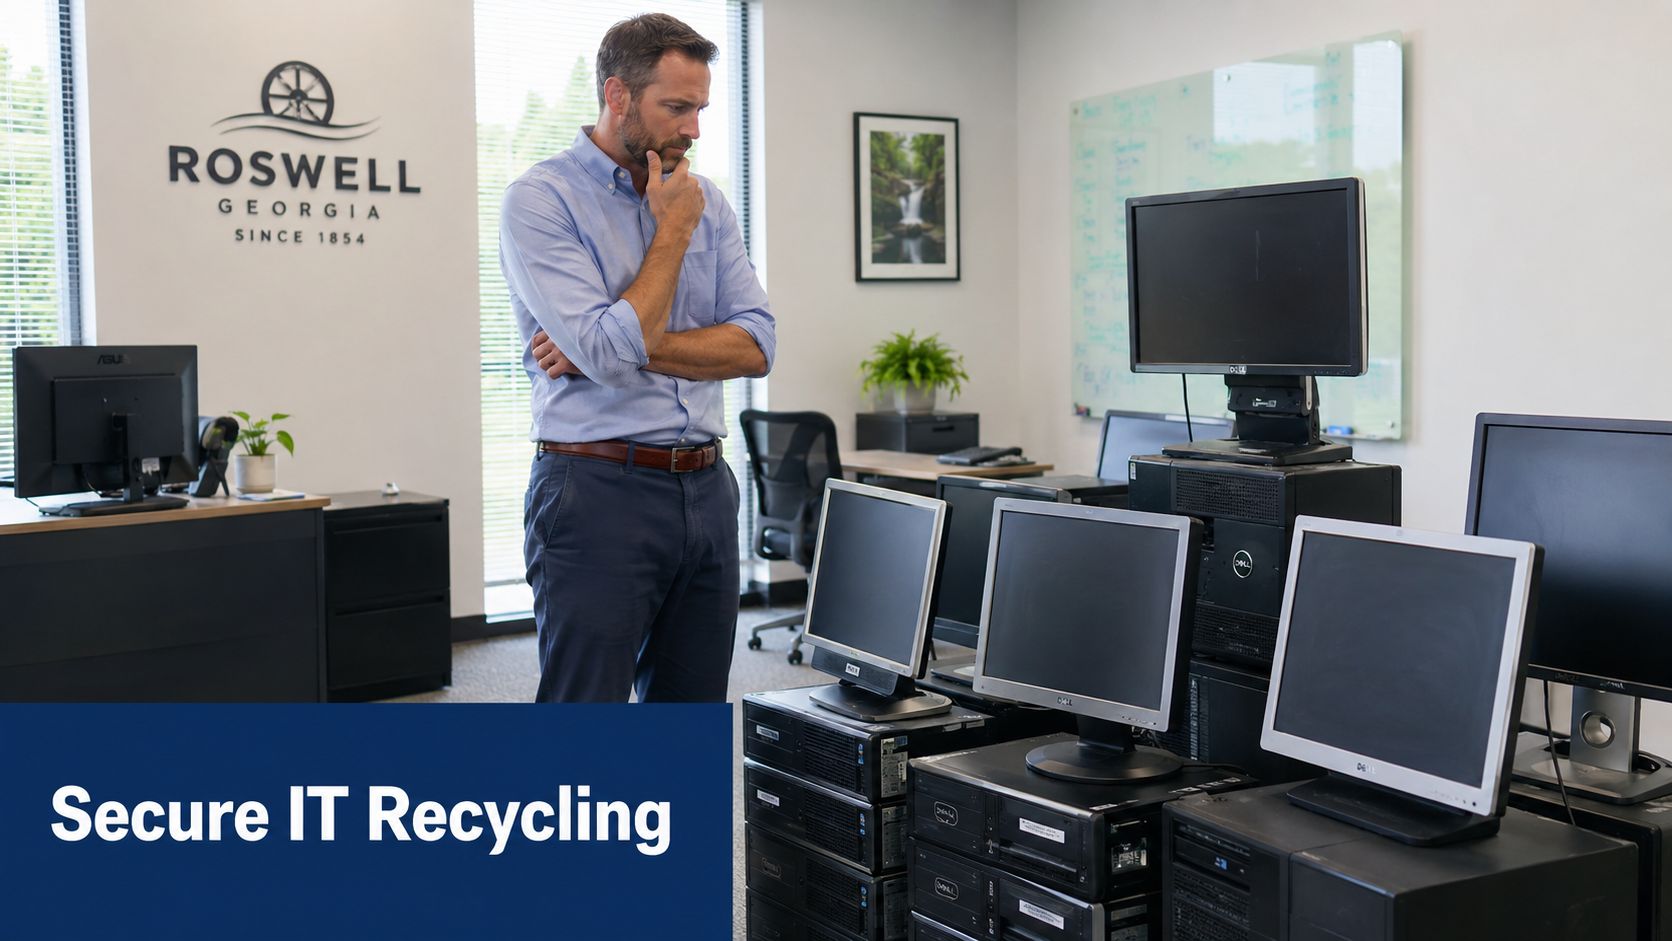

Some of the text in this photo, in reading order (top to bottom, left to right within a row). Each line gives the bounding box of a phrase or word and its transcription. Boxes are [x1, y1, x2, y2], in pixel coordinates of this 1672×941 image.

[168, 145, 422, 195] ROSWELL
[217, 198, 381, 220] GEORGIA
[234, 228, 366, 246] SINCE 1854
